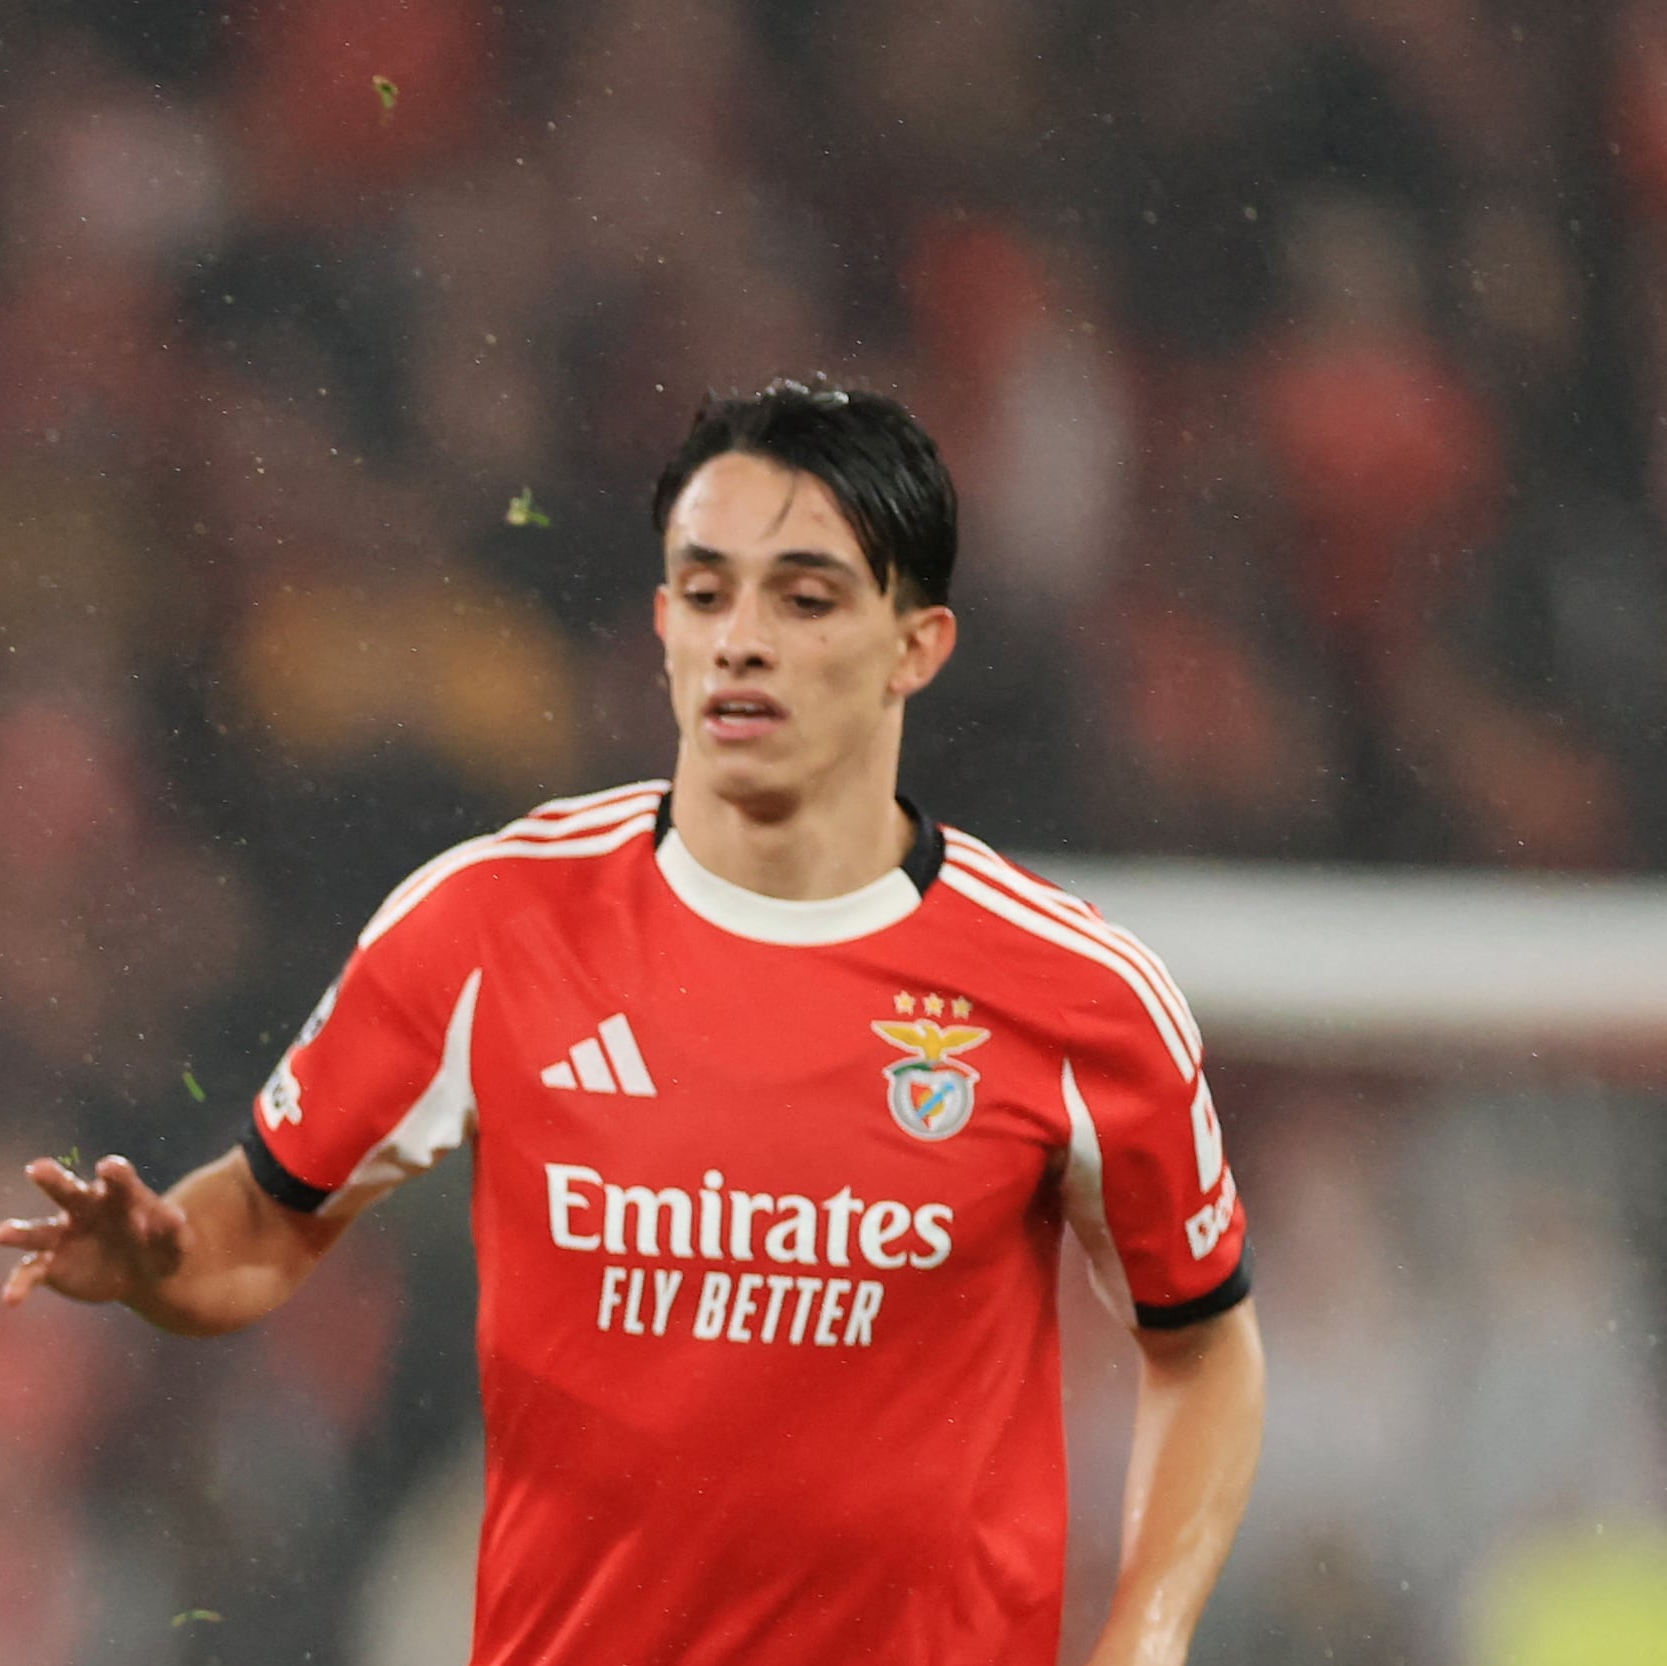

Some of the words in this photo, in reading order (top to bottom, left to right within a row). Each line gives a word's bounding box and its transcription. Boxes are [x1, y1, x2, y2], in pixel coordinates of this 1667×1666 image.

[544, 1162, 953, 1270] Emirates
[597, 1265, 684, 1337] FLY
[692, 1270, 884, 1346] BETTER
